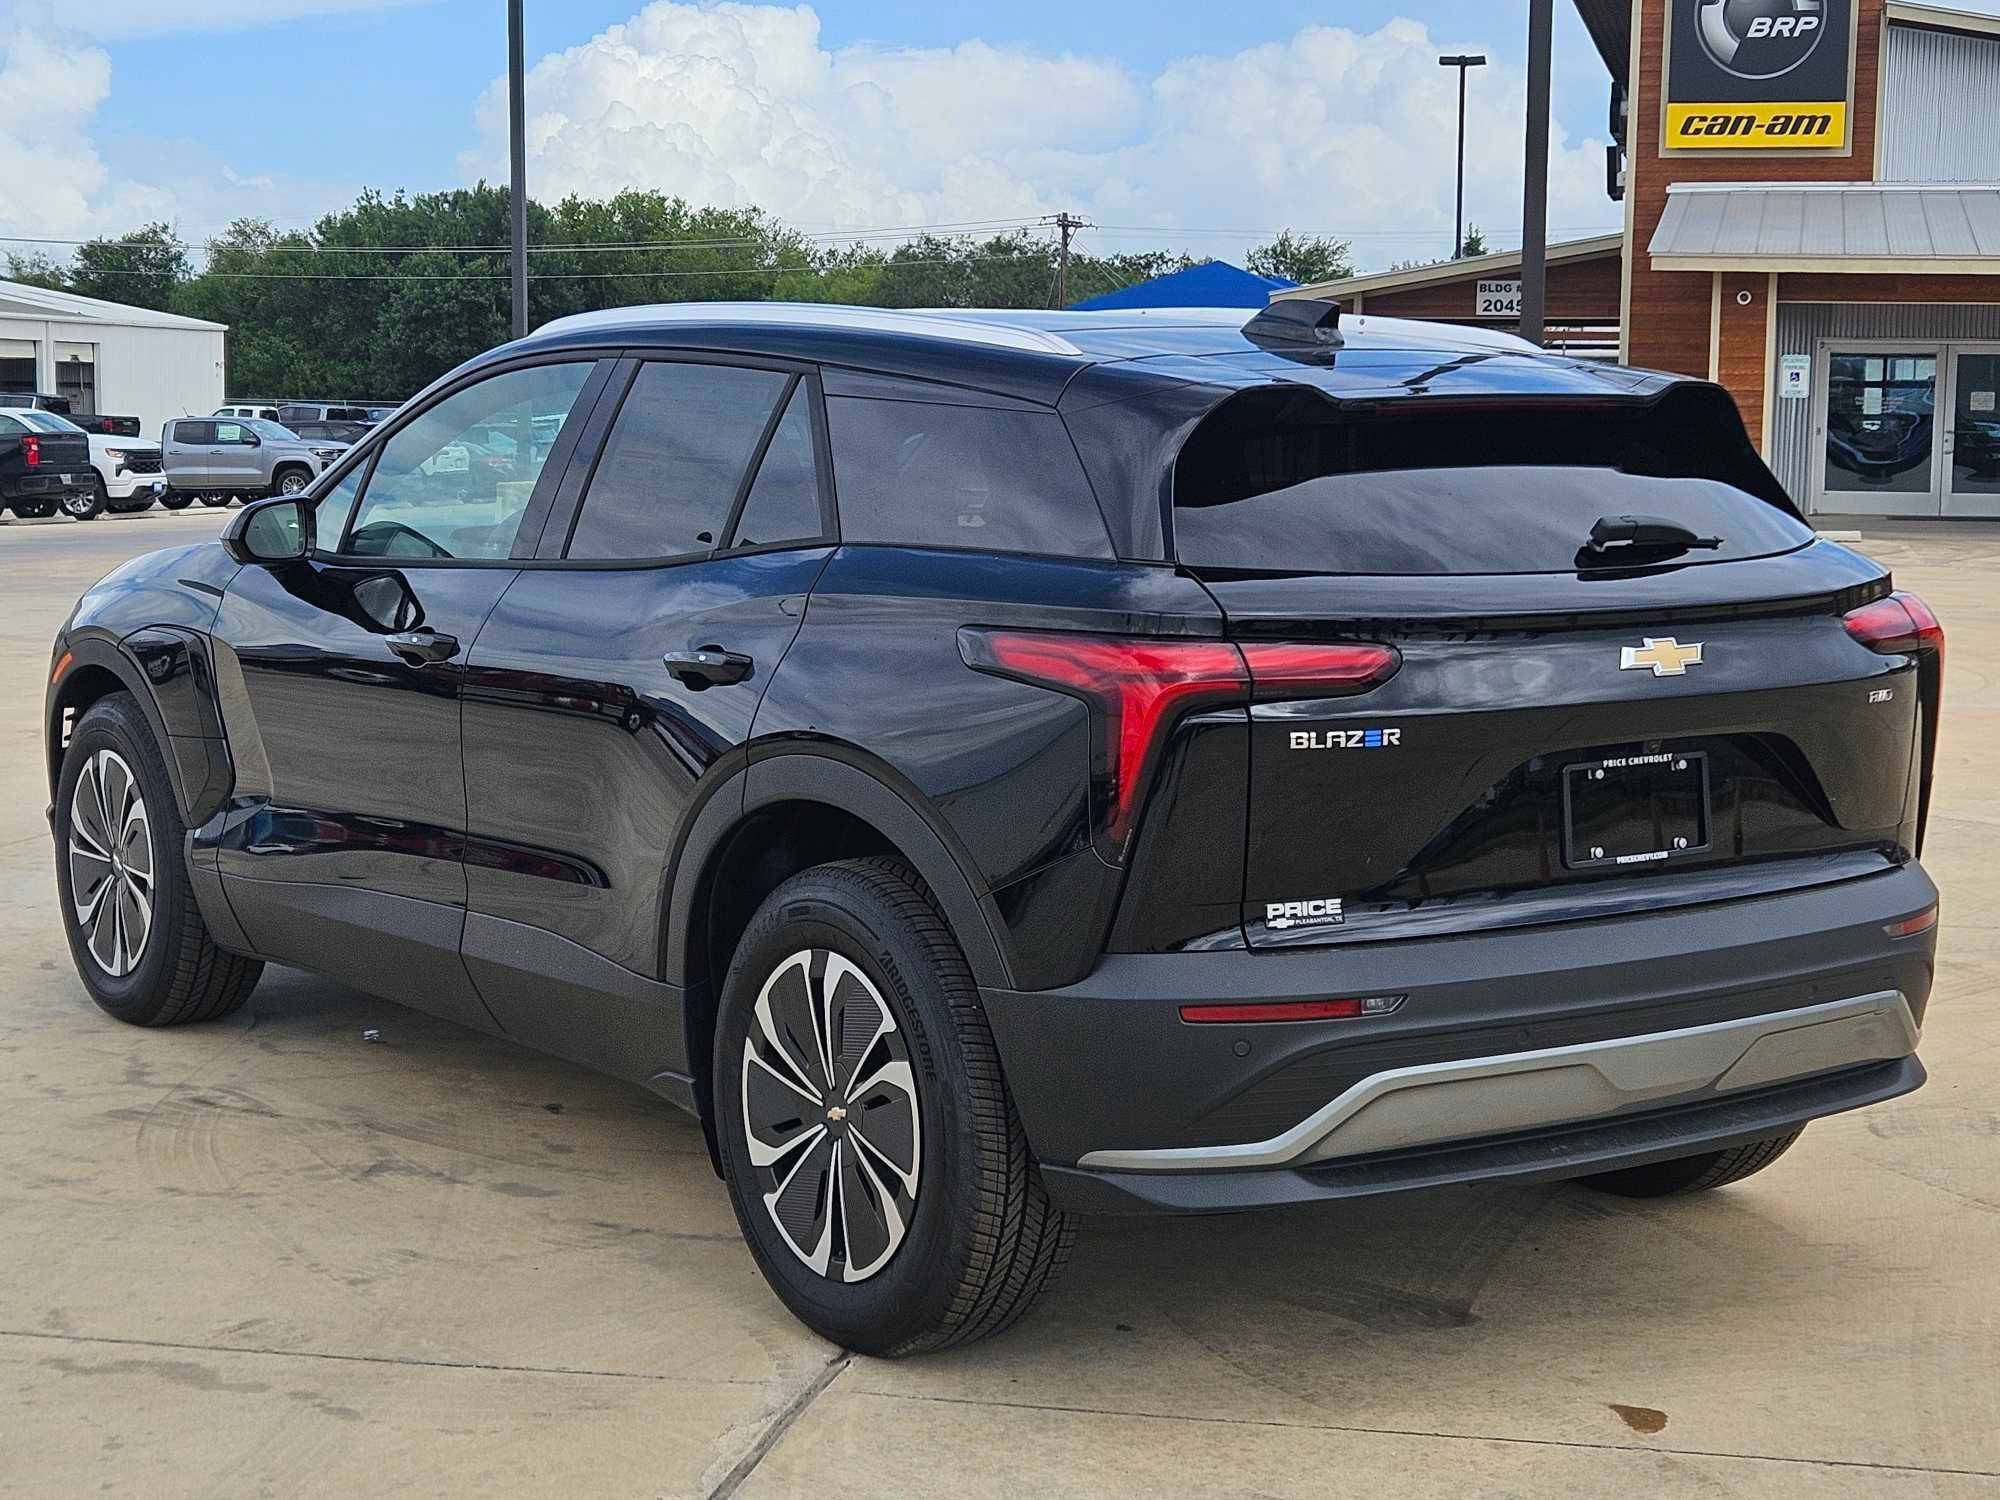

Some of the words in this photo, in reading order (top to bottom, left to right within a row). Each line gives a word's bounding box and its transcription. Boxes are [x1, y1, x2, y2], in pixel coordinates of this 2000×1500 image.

[1746, 16, 1819, 38] BRP
[1680, 114, 1832, 136] can-am
[1480, 283, 1512, 293] BLDG
[1289, 728, 1401, 749] BLAZER
[1602, 758, 1626, 768] PRICE
[1628, 753, 1673, 766] CHEVROLET
[1266, 898, 1342, 919] PRICE
